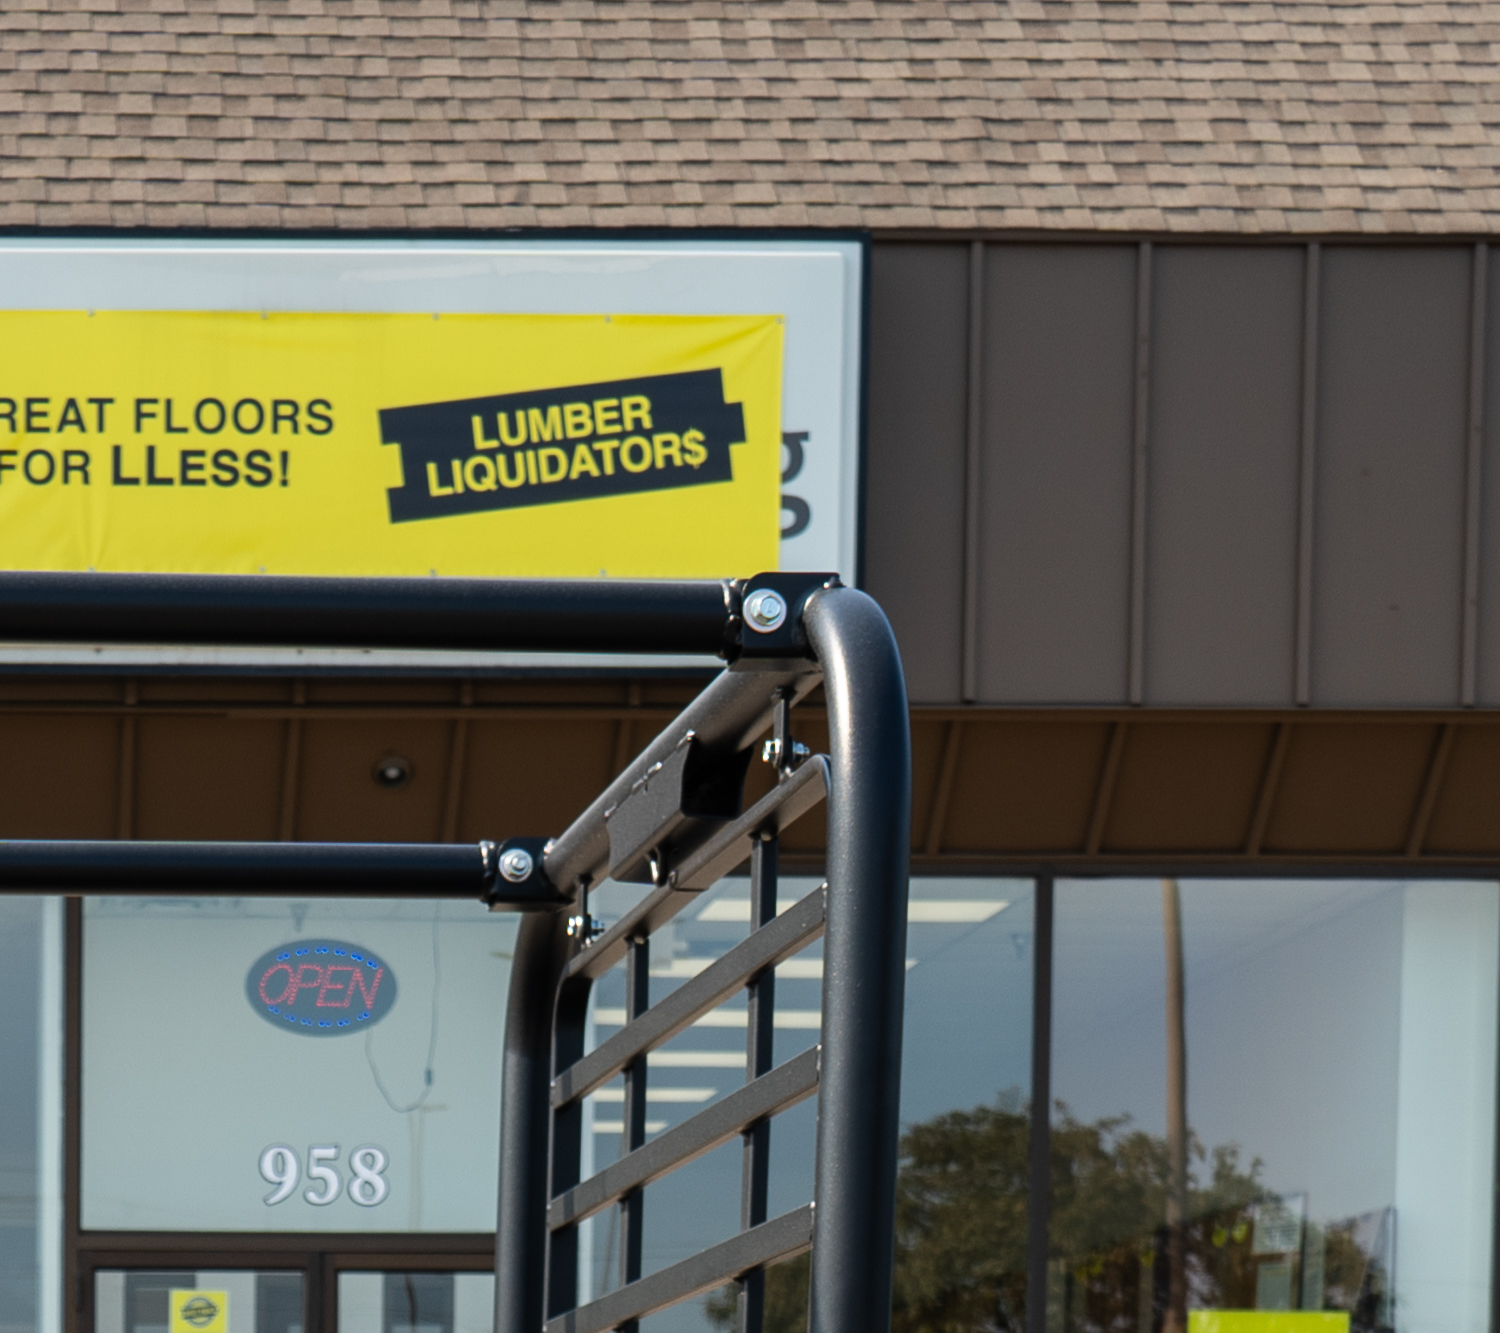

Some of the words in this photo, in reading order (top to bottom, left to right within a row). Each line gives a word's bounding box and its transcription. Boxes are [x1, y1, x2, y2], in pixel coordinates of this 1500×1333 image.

[134, 397, 334, 435] FLOORS
[471, 394, 653, 451] LUMBER
[111, 444, 290, 488] LLESS!
[258, 963, 384, 1010] OPEN
[258, 1144, 390, 1207] 958
